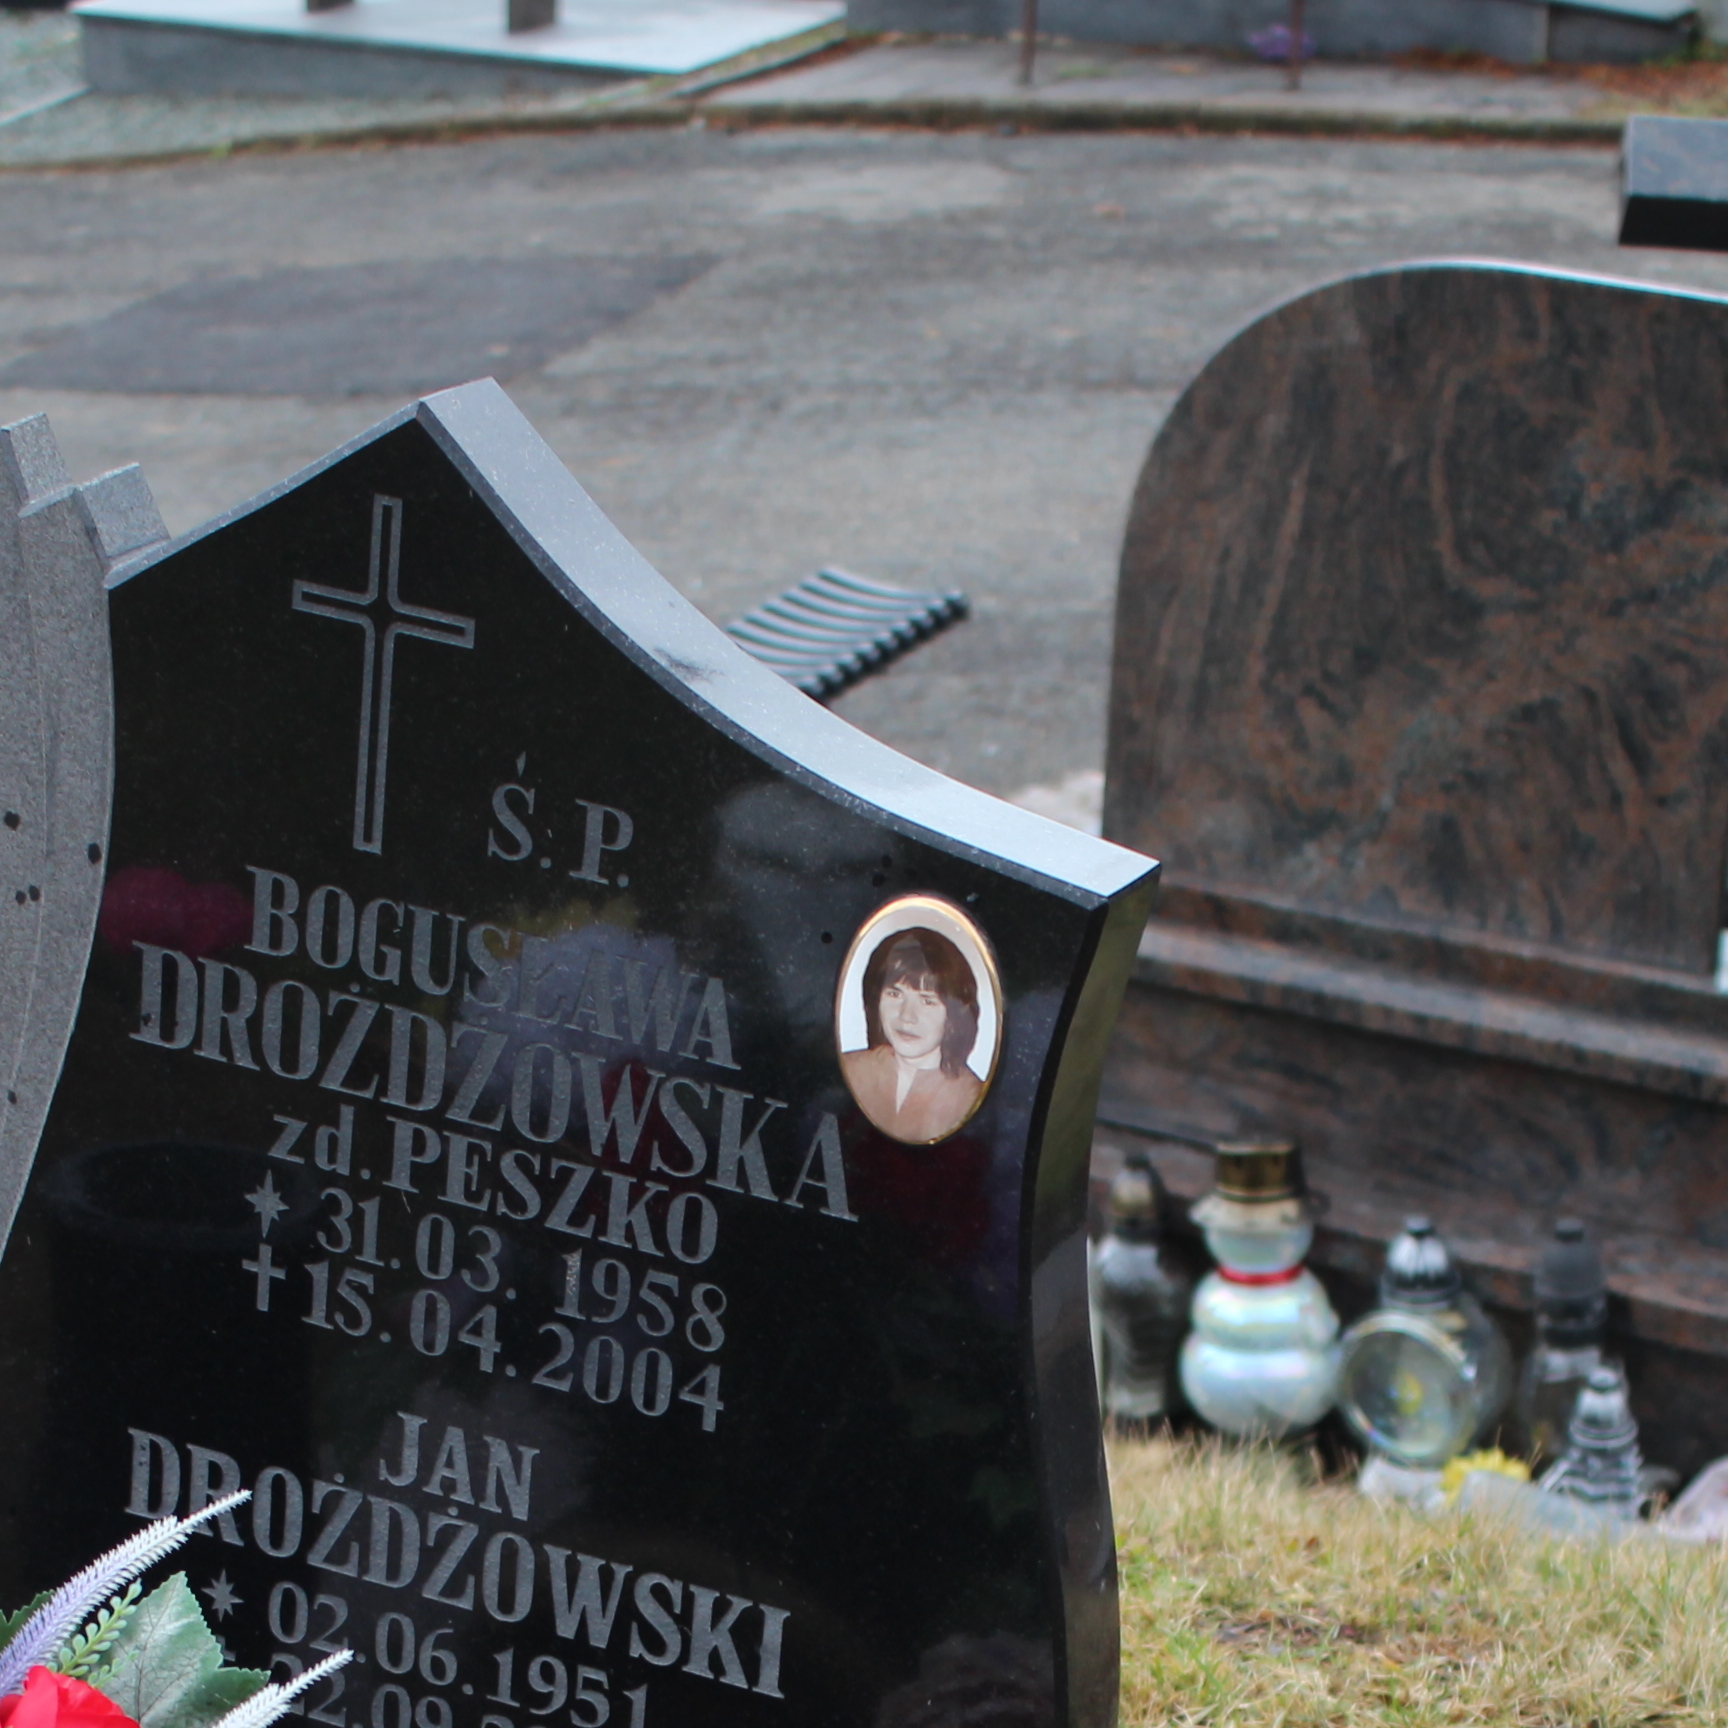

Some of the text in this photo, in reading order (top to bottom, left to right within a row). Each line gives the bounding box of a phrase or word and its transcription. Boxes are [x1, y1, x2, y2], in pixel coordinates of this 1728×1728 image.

[129, 940, 859, 1222] DROŻDŻOWSKA
[244, 865, 742, 1071] BOGUSŁAWA
[124, 1427, 792, 1700] DROŻDŻOWSKI
[379, 1411, 540, 1522] JAN
